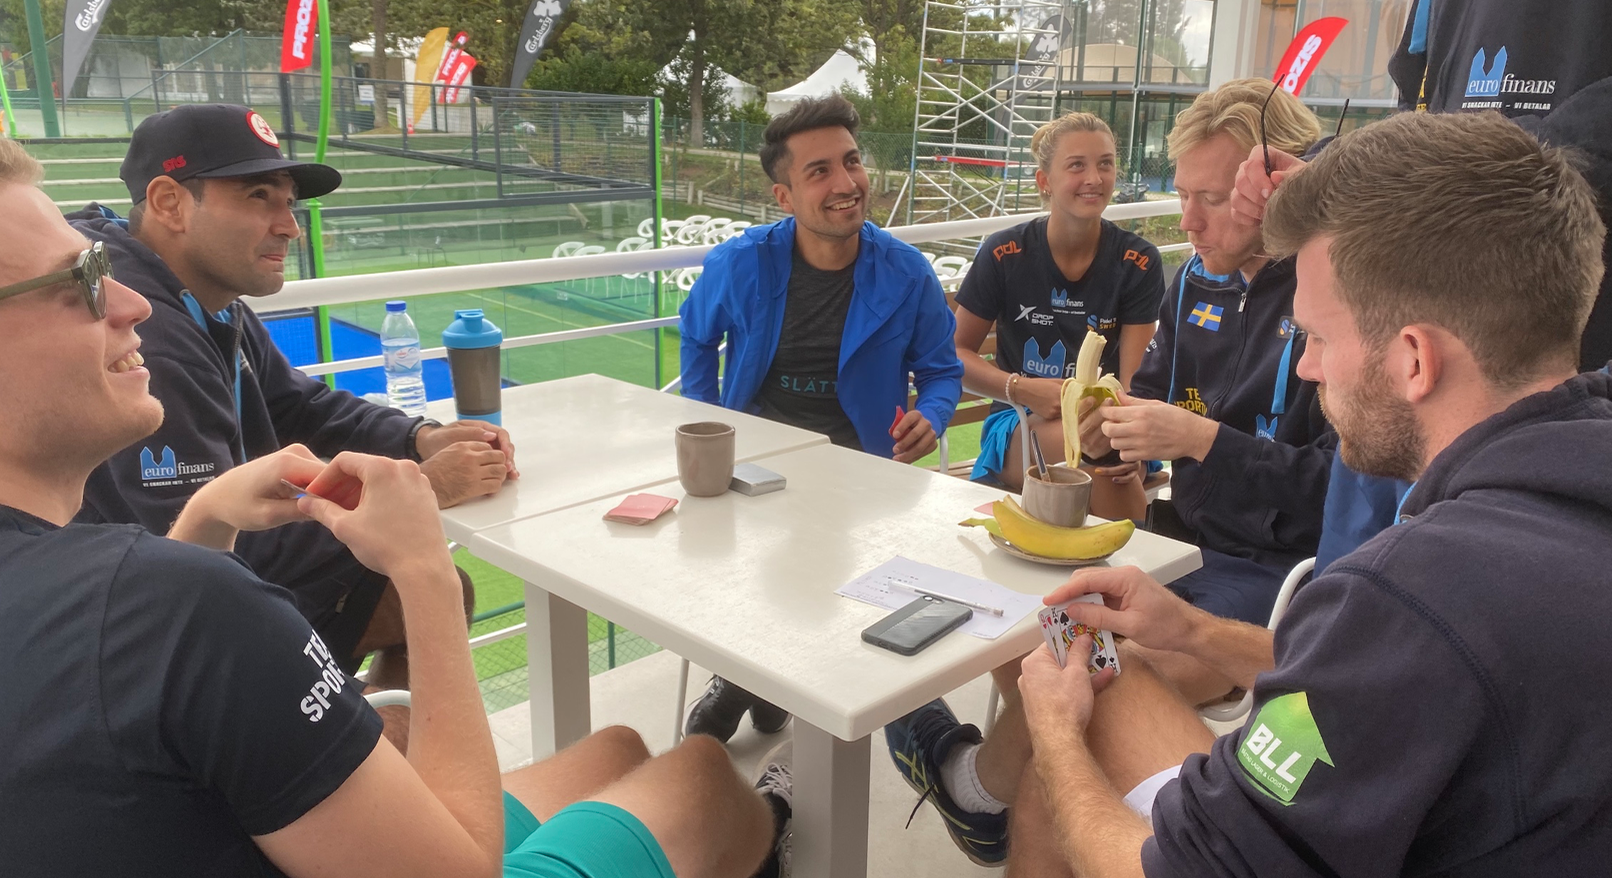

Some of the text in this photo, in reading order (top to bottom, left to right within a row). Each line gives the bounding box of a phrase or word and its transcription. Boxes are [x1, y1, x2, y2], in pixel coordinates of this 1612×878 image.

[525, 16, 553, 53] Carlsberg
[1468, 73, 1556, 94] euro finans
[1027, 359, 1059, 376] euro
[144, 462, 215, 477] euro finans
[1246, 722, 1302, 784] BLL
